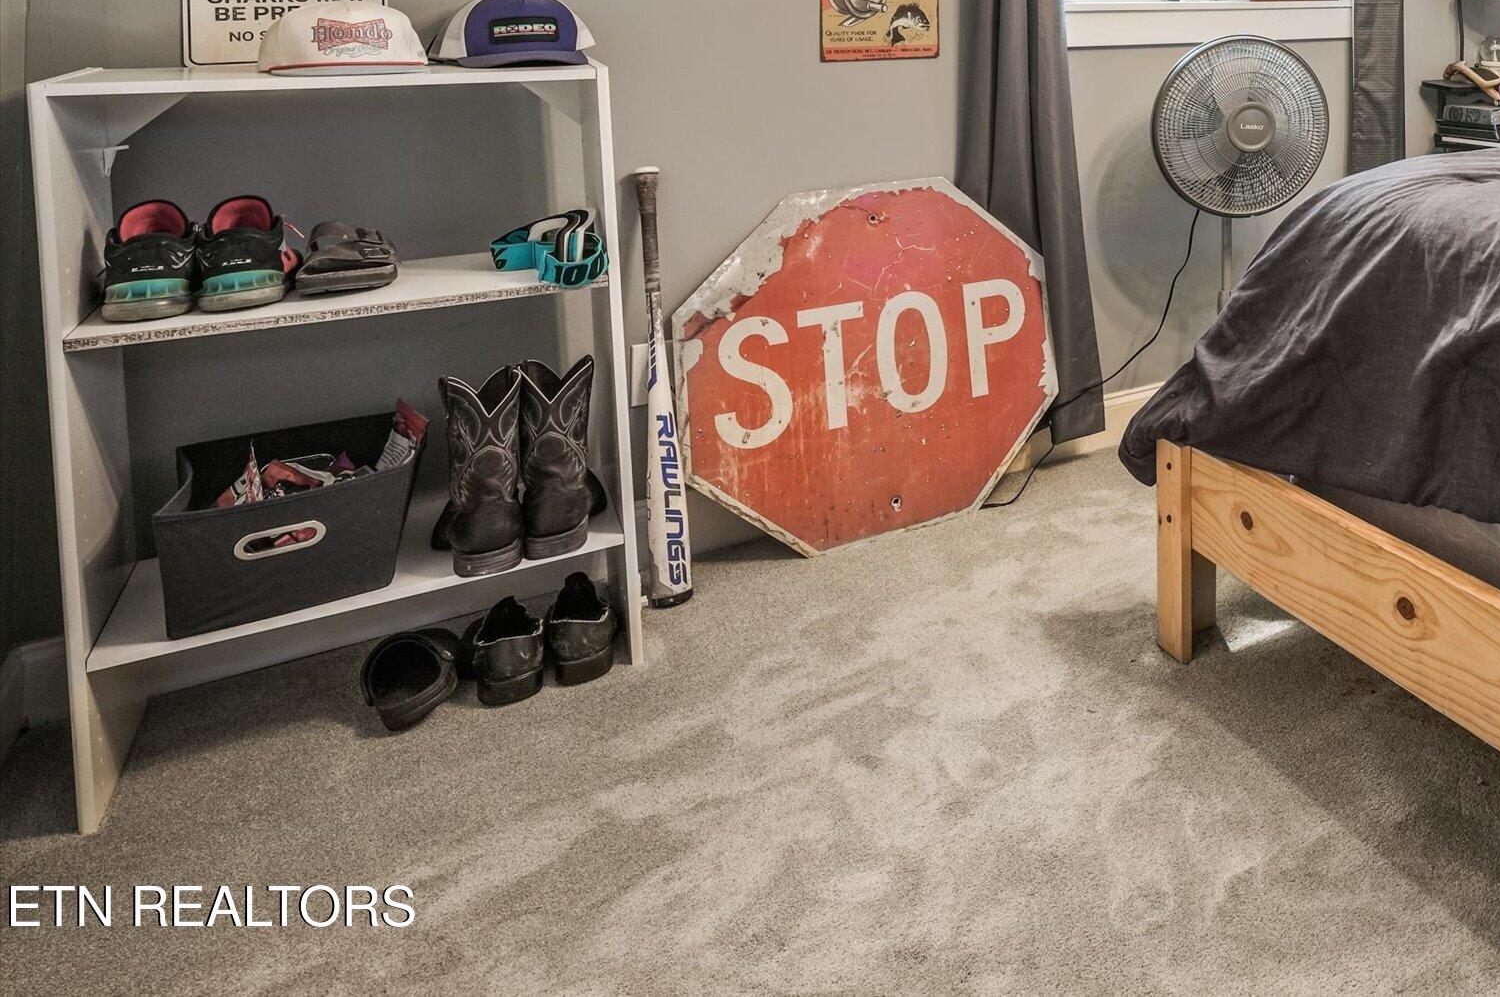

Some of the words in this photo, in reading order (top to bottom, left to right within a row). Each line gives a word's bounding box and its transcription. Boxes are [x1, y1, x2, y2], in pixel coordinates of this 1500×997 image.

[215, 7, 246, 21] BE
[229, 31, 254, 42] NO
[311, 24, 393, 43] Hondo
[713, 277, 1026, 449] STOP
[656, 411, 688, 586] RAWLINGS
